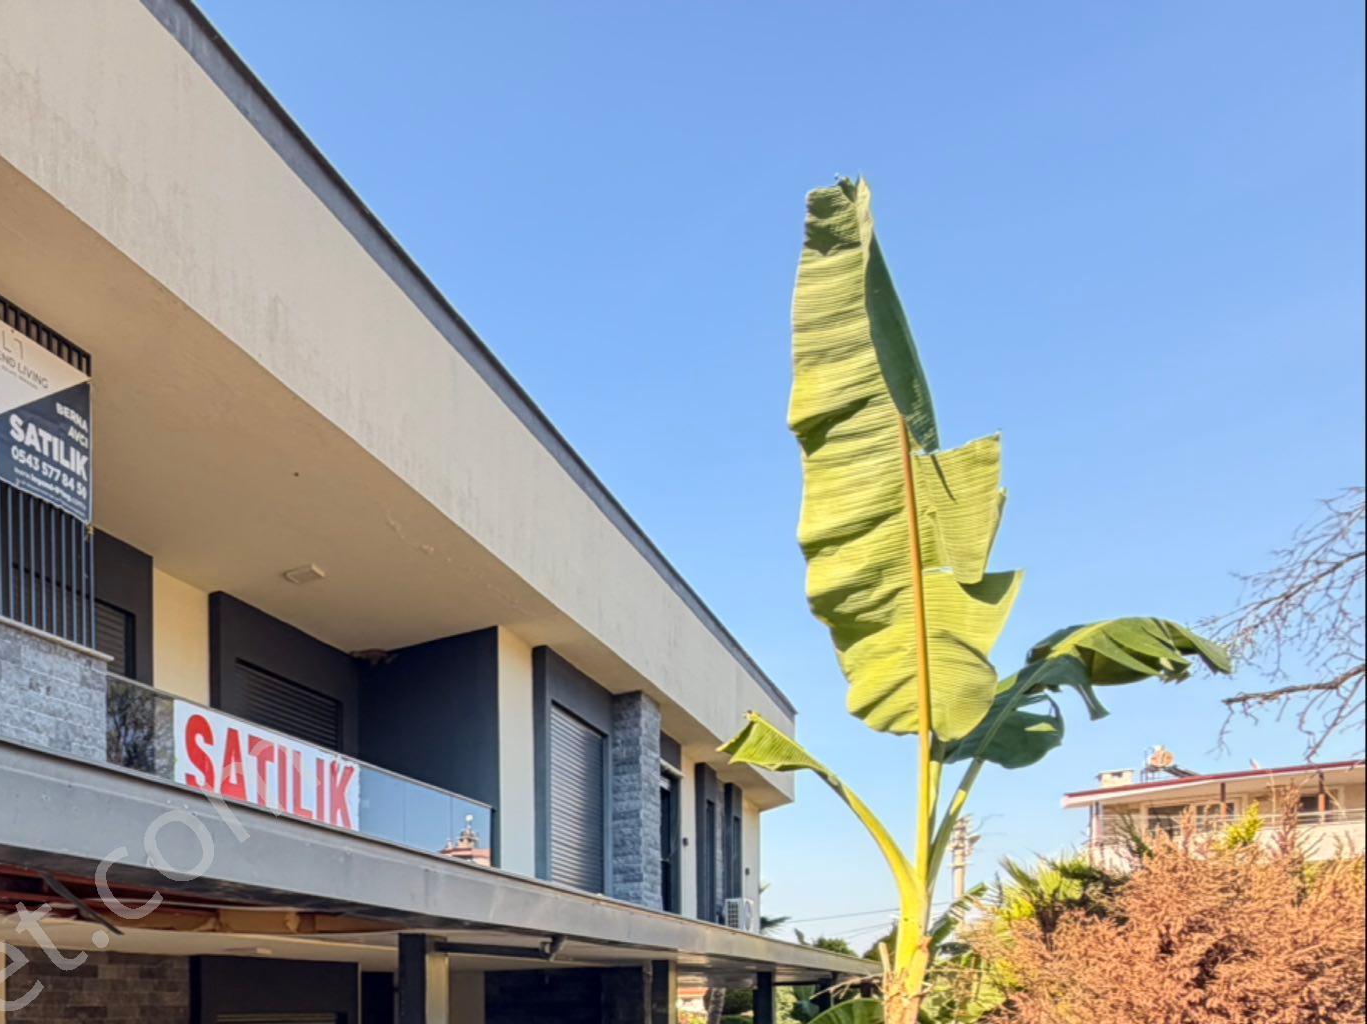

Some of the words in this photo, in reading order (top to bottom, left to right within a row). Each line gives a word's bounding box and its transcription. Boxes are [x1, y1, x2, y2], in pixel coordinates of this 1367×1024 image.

[17, 361, 49, 389] LIVING
[10, 413, 88, 482] SATILIK
[11, 444, 40, 472] 0543
[41, 461, 61, 482] 577
[184, 713, 355, 831] SATILIK
